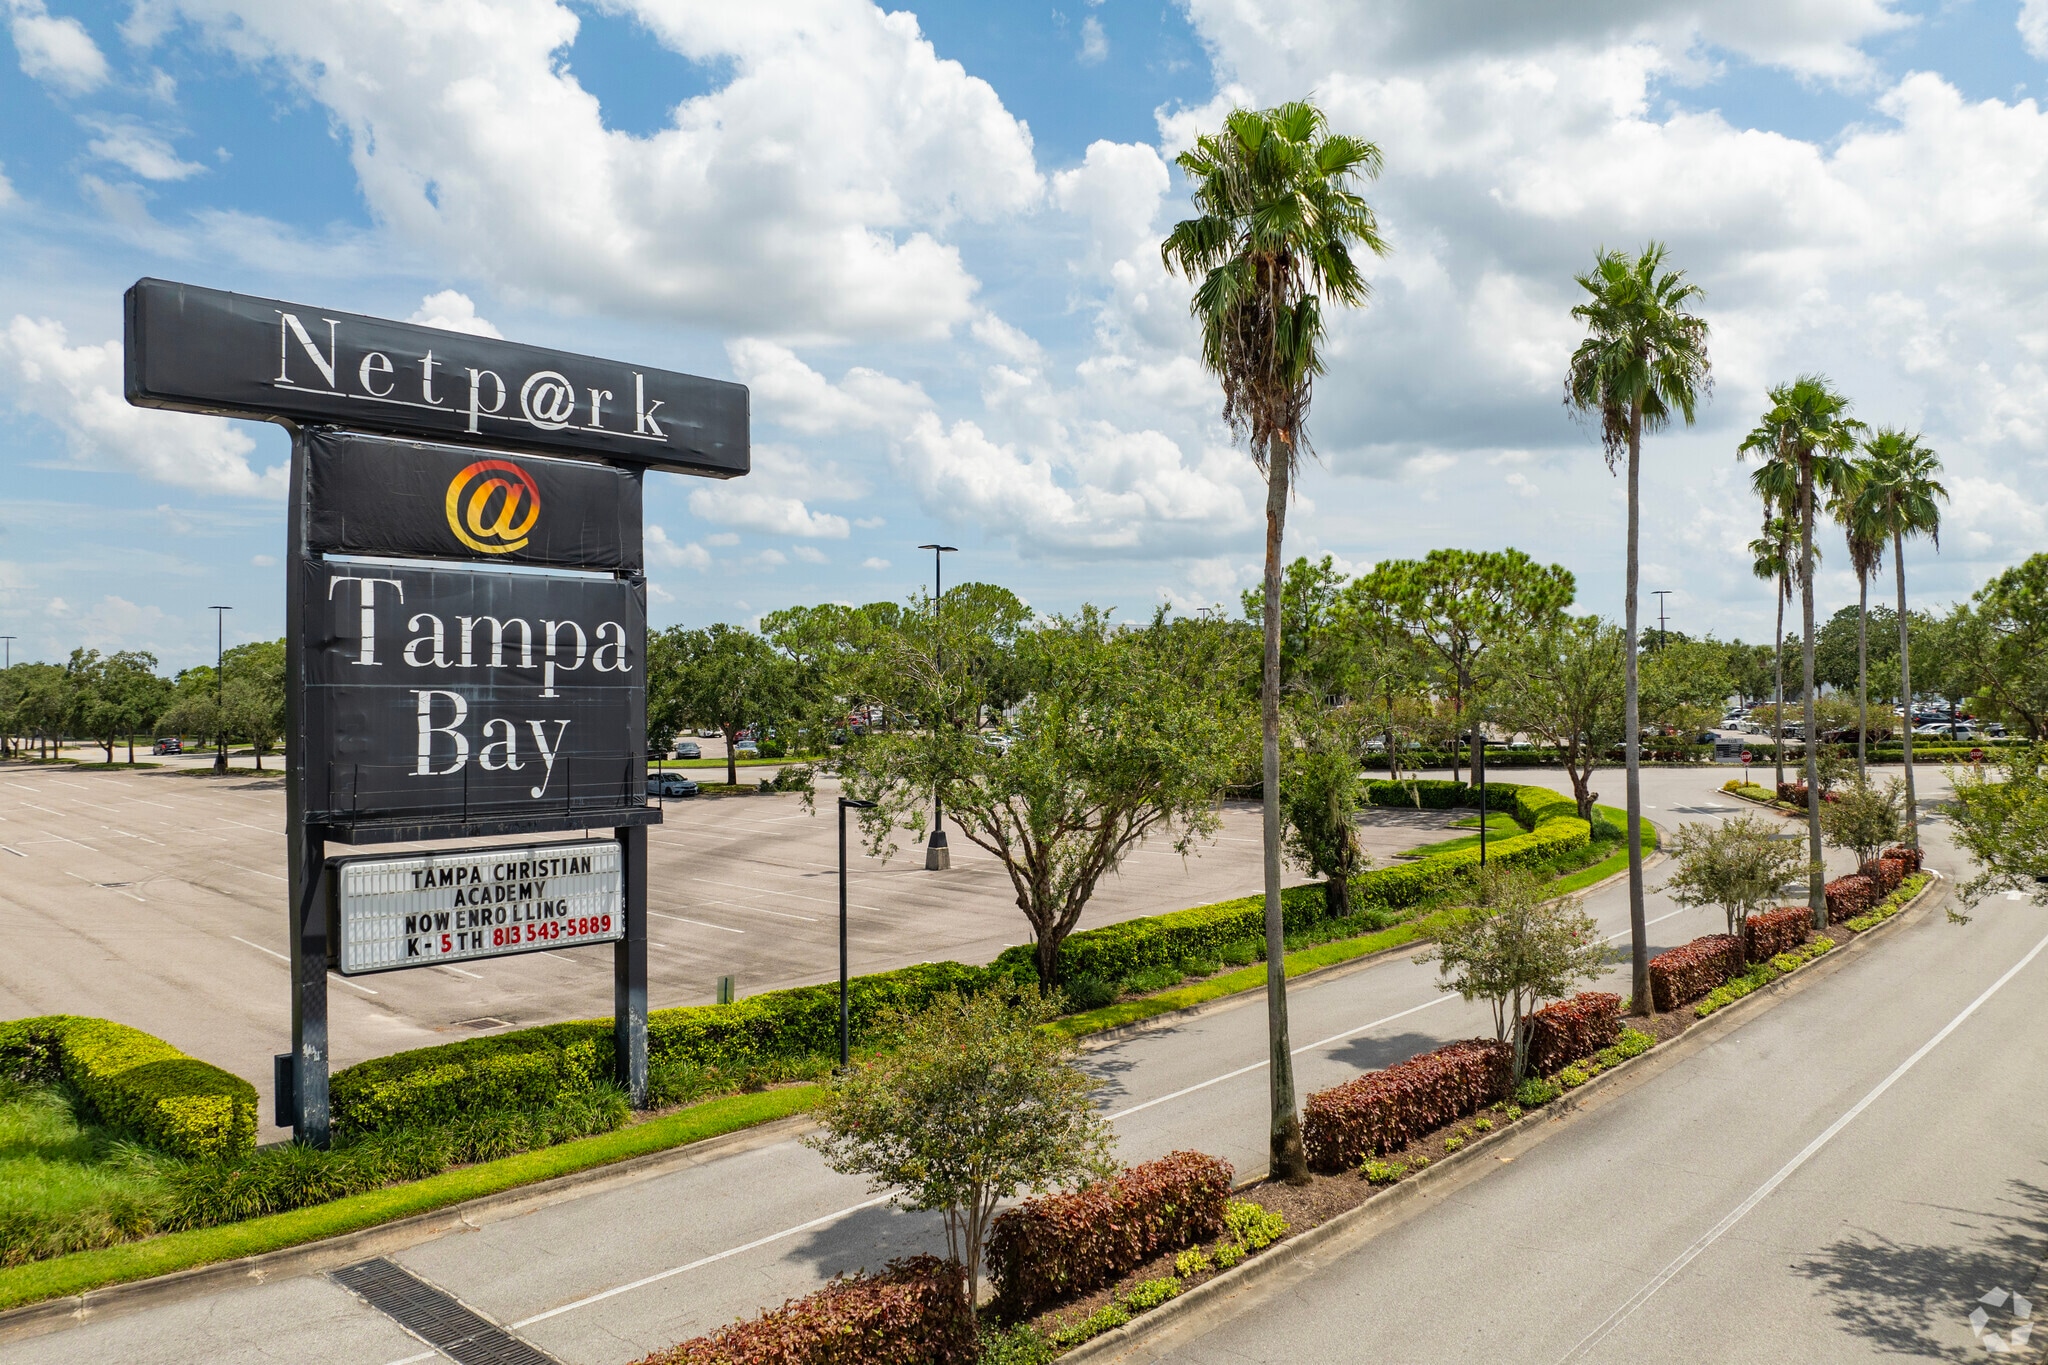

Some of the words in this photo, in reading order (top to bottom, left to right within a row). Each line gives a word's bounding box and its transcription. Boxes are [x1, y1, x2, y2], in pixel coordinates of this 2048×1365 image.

[274, 310, 667, 437] Netp@rk
[446, 459, 541, 554] @
[329, 575, 633, 697] Tampa
[408, 689, 571, 798] Bay
[411, 866, 482, 889] TAMPA
[493, 856, 591, 881] CHRISTIAN
[454, 881, 546, 907] ACADEMY
[493, 926, 521, 946] 813
[526, 914, 611, 941] 543-5889
